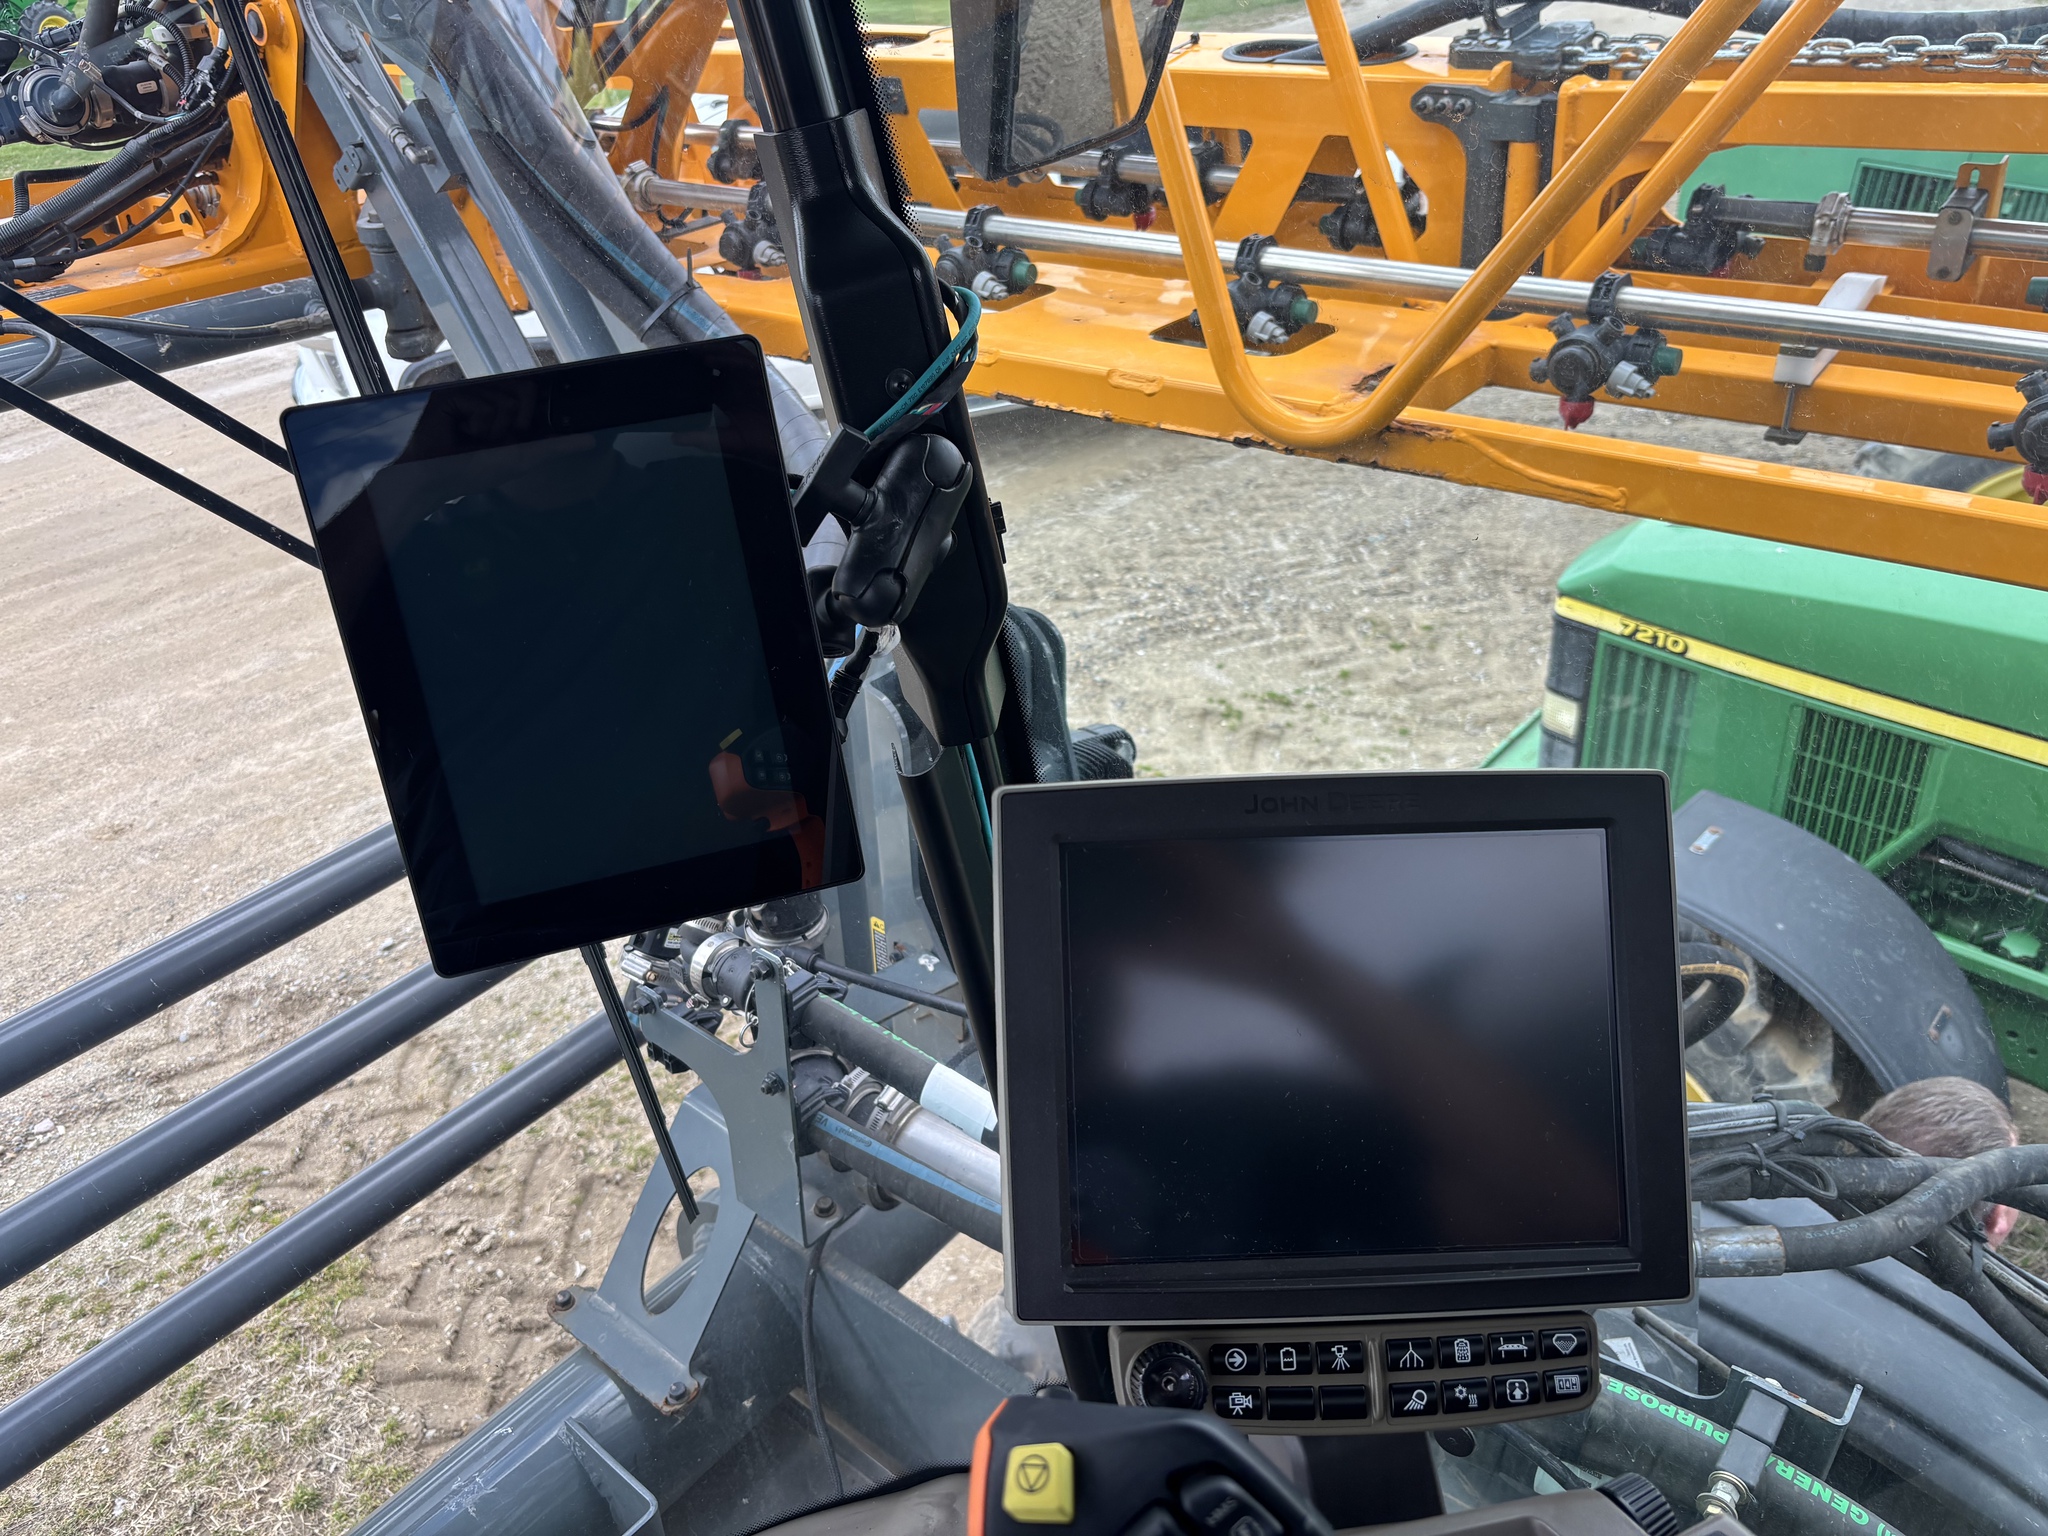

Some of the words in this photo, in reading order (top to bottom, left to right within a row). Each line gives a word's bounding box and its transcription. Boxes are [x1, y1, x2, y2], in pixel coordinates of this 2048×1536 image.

[1618, 616, 1689, 656] 7210
[1244, 794, 1319, 814] JOHN
[1328, 791, 1421, 812] DEERE
[837, 1127, 873, 1148] Continental
[1606, 1378, 1730, 1446] PURPOSE
